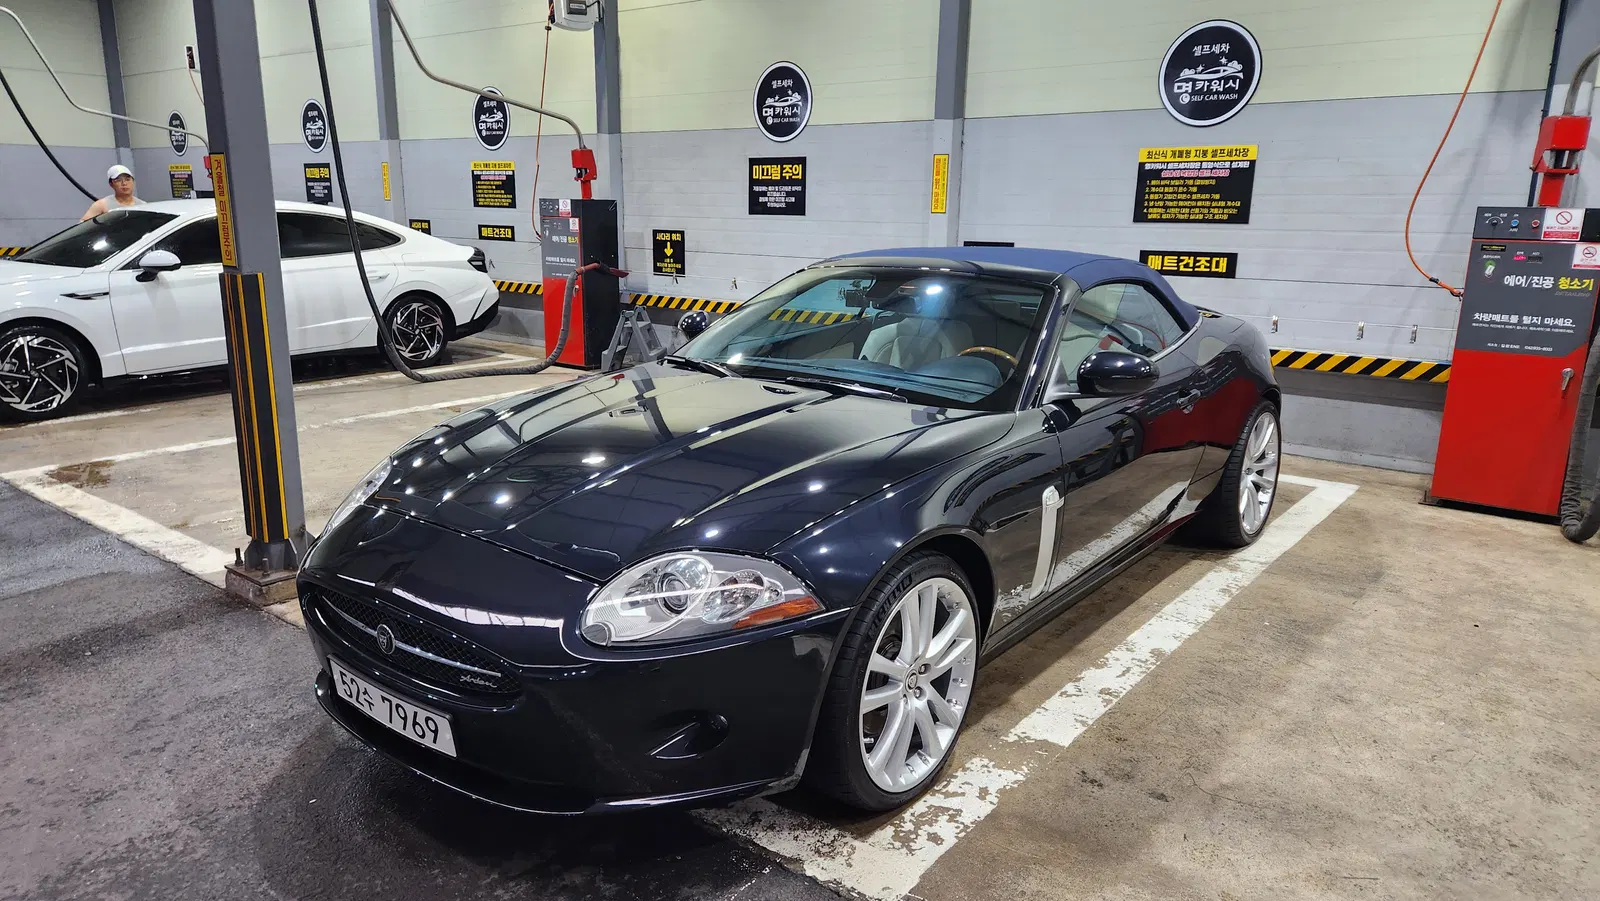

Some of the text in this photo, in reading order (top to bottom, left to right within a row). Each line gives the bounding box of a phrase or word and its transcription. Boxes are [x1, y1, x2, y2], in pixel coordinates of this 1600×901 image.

[1192, 43, 1230, 56] 셀프세차
[771, 79, 793, 88] 셀프세차
[1173, 79, 1240, 100] 명카워시
[1191, 94, 1204, 102] SELF
[762, 106, 800, 121] 명카워시
[1146, 148, 1250, 160] 최신식 개폐형 지붕 셀프세차장
[752, 164, 802, 180] 미끄럼 주의
[1147, 255, 1228, 273] 매트건조대
[1504, 274, 1594, 290] 에어/진공 청소기
[1473, 312, 1576, 327] 차량매트를 털지 마세요.
[339, 670, 439, 744] 52수 7969
